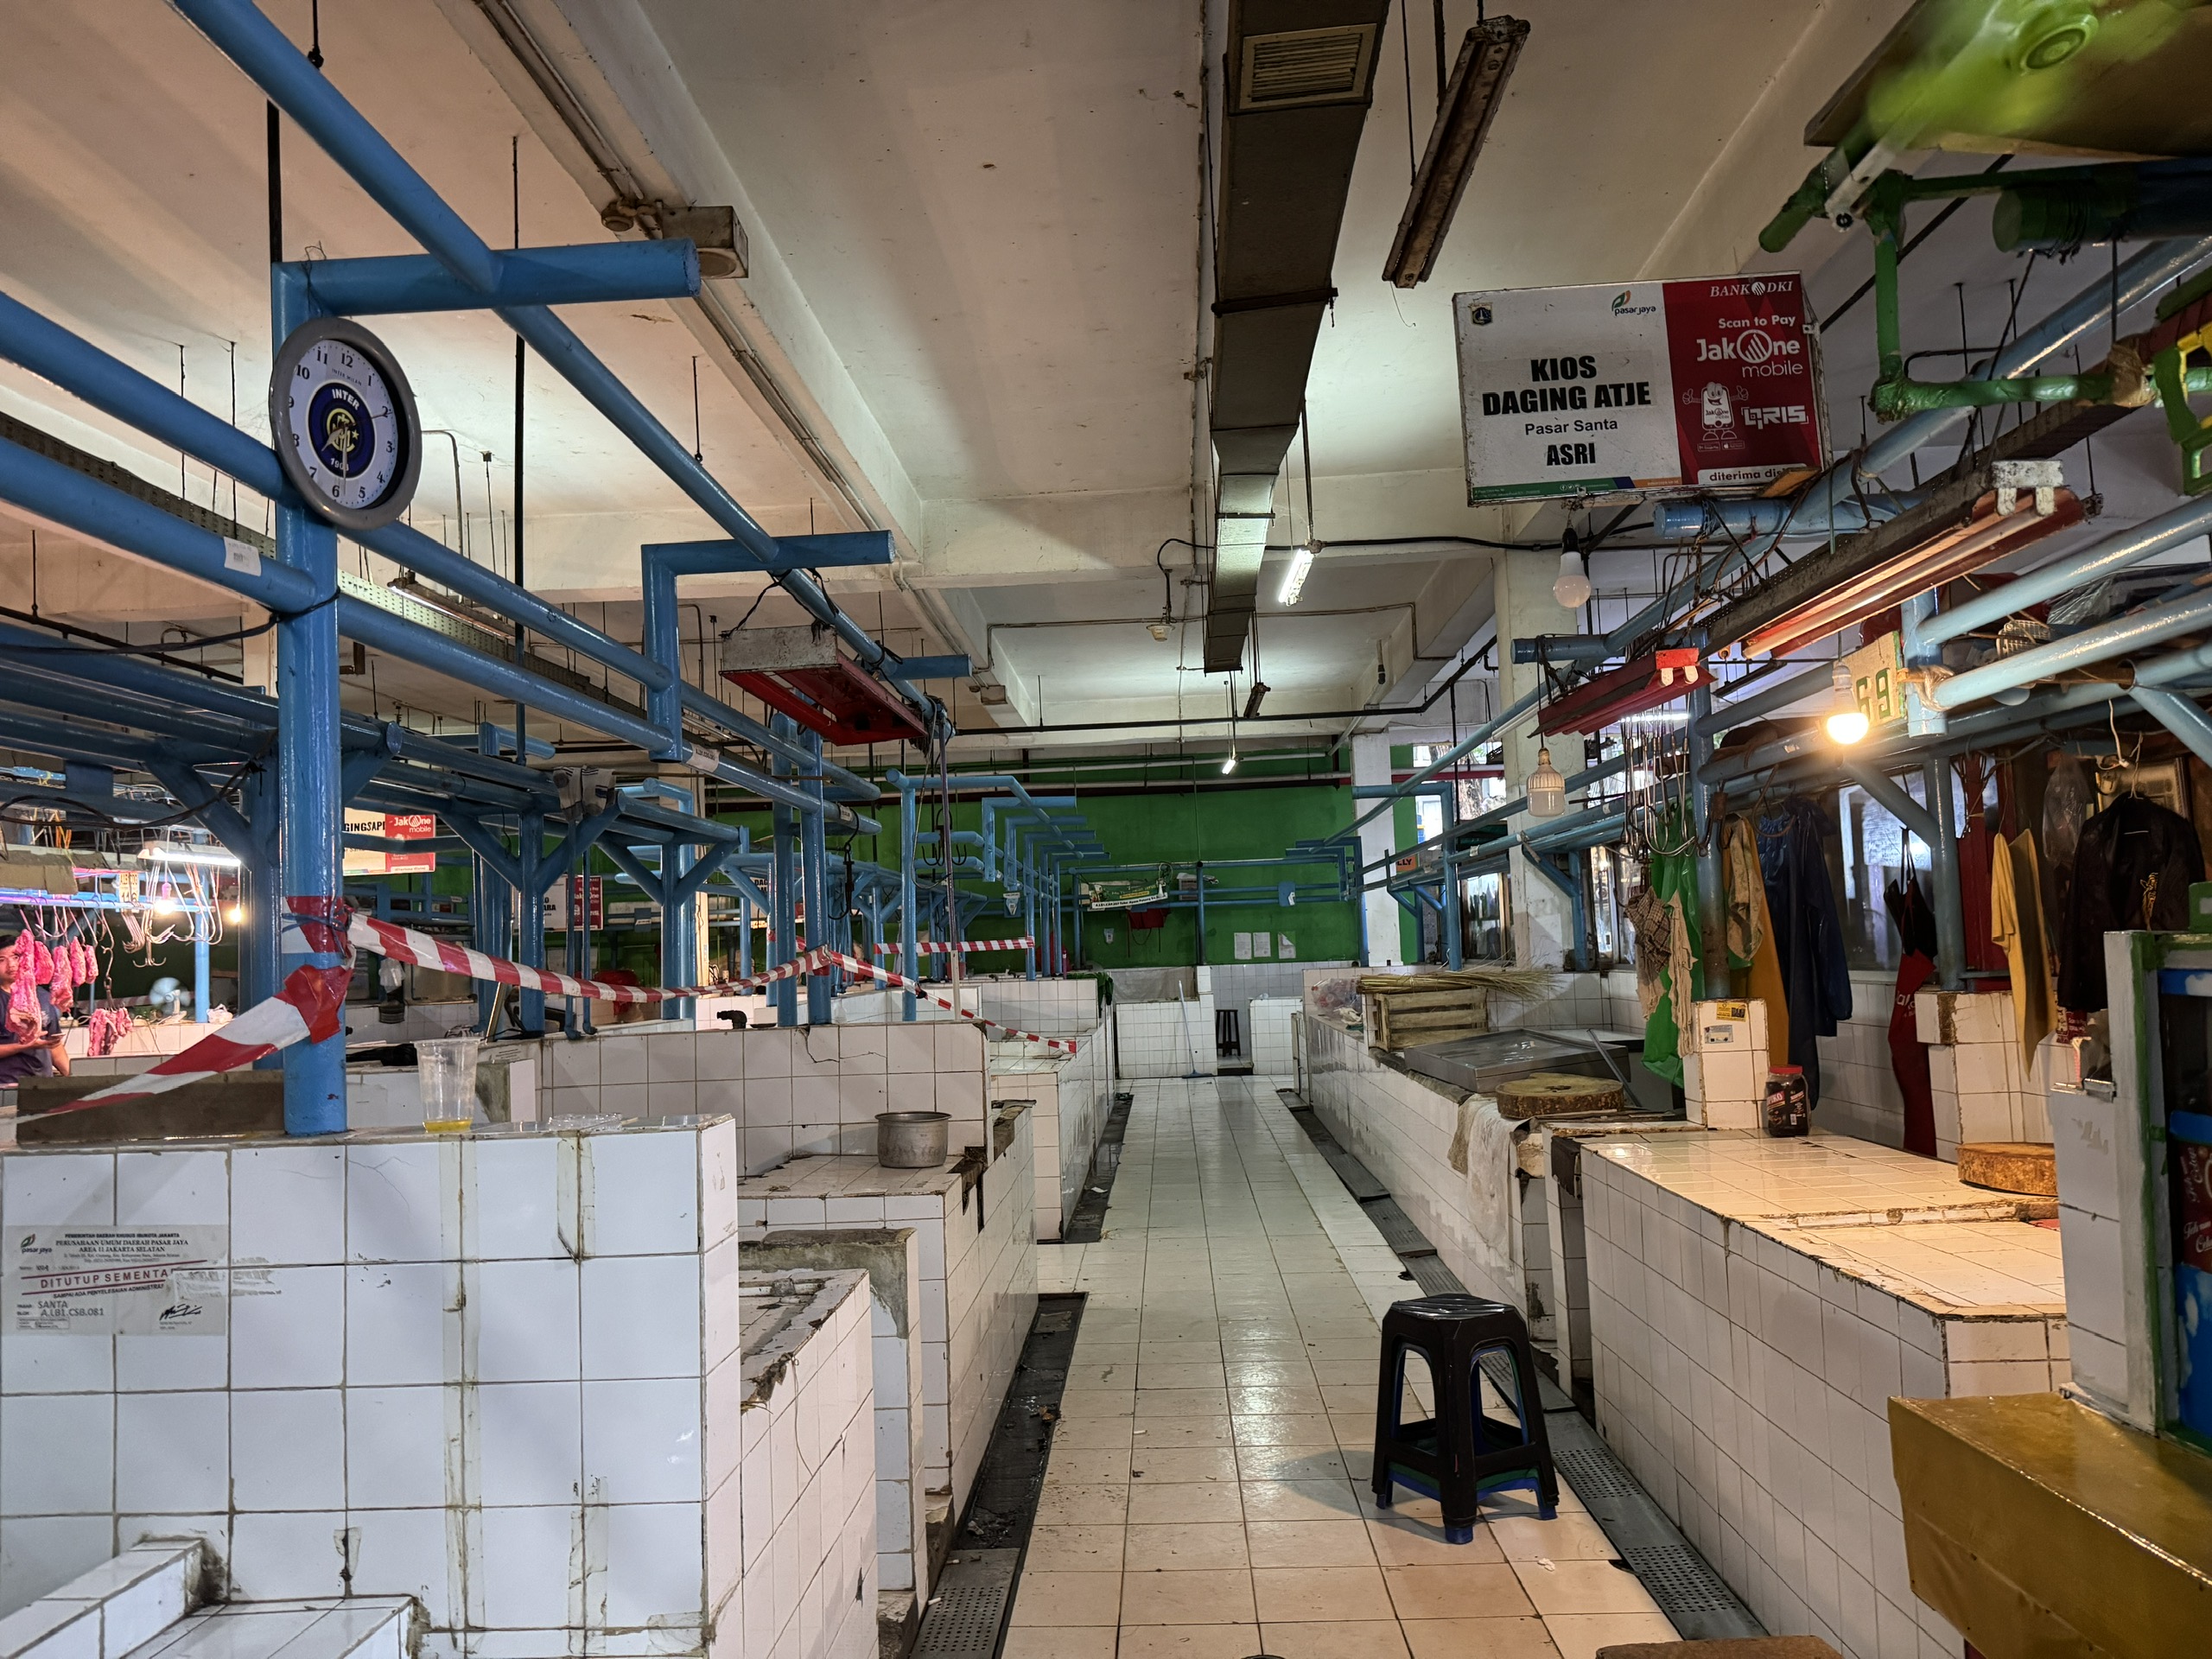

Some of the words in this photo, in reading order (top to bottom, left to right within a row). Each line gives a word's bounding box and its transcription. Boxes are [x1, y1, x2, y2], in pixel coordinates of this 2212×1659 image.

[1710, 283, 1751, 297] BANK
[1767, 281, 1794, 293] DKI
[1718, 318, 1750, 328] Scan
[1753, 316, 1768, 327] to
[1771, 315, 1796, 327] Pay
[1696, 329, 1801, 364] JakOne
[317, 349, 327, 365] 11
[341, 353, 353, 368] 12
[296, 364, 310, 380] 10
[1530, 355, 1597, 382] KIOS
[1742, 360, 1803, 378] mobile
[332, 388, 360, 411] INTER
[1482, 385, 1587, 416] DAGING
[1594, 381, 1651, 408] ATJE
[1744, 405, 1807, 429] QRIS
[1525, 421, 1569, 435] Pasar
[1573, 418, 1618, 432] Santa
[386, 441, 393, 454] 3
[1547, 442, 1596, 466] ASRI
[377, 471, 385, 484] 4
[1709, 470, 1761, 481] diterima
[332, 485, 340, 499] 6
[359, 486, 366, 499] 5
[394, 815, 431, 827] JakOne
[41, 1274, 99, 1288] DITUTUP
[105, 1268, 173, 1282] SEMENTA
[38, 1300, 68, 1309] SANTA
